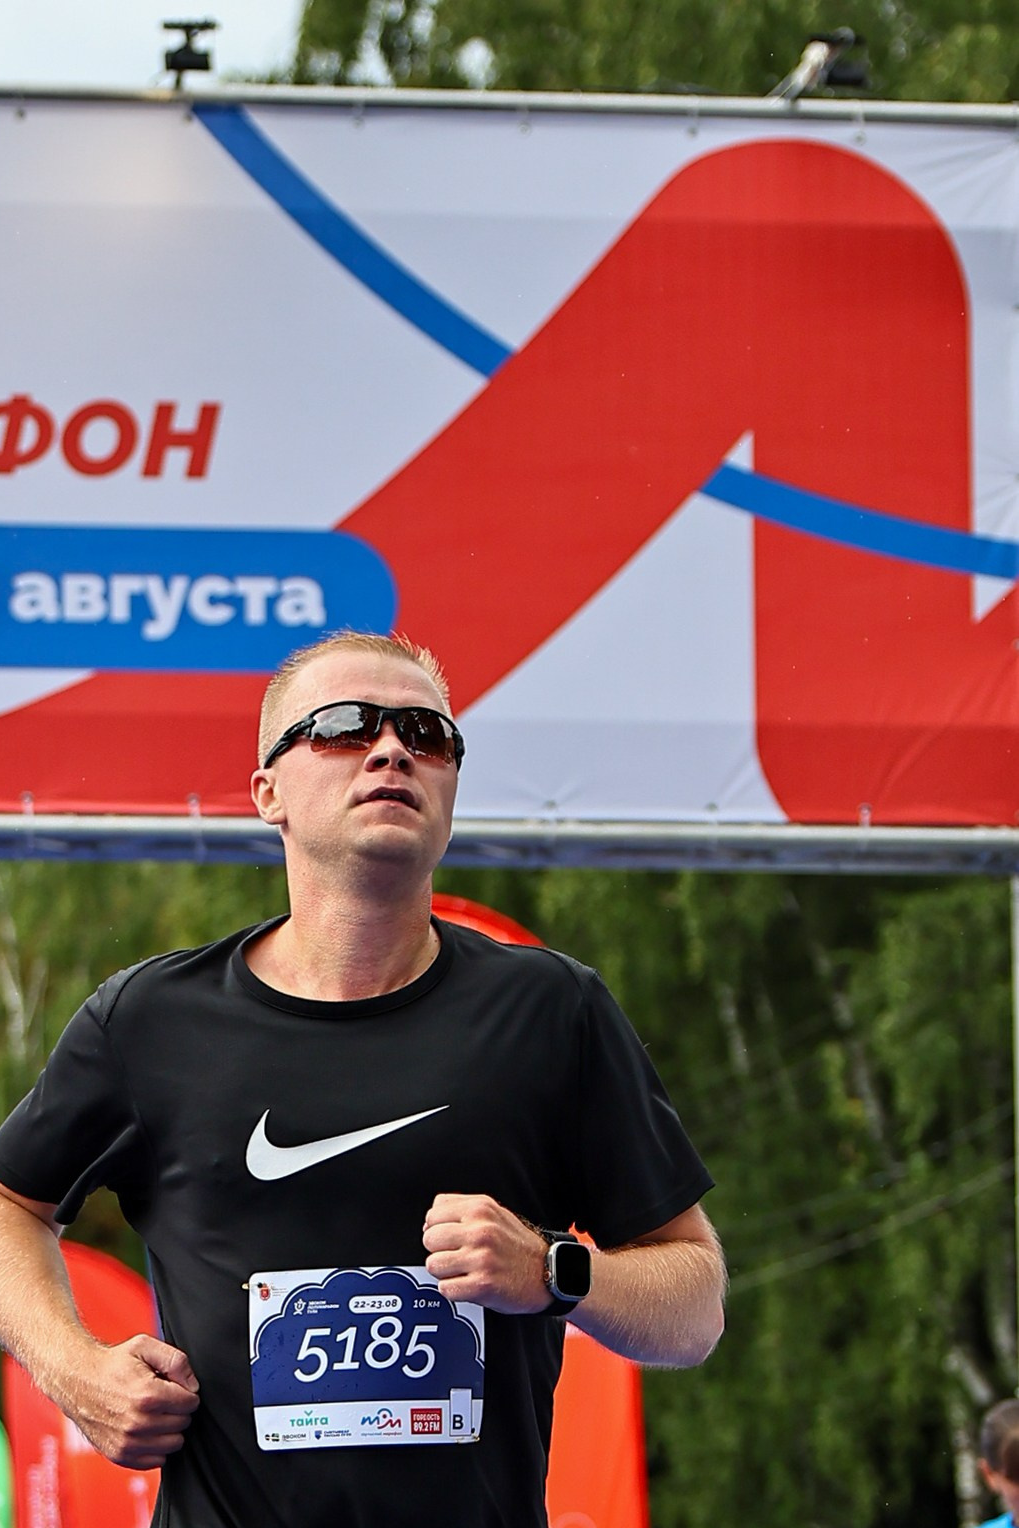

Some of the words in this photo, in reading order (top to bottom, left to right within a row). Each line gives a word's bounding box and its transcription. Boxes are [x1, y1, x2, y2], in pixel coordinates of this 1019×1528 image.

[11, 569, 326, 641] августа
[354, 1299, 398, 1309] 22-23.08
[413, 1299, 426, 1308] 10
[294, 1316, 438, 1383] 5185
[290, 1410, 329, 1427] тайга
[452, 1414, 464, 1430] B
[413, 1422, 428, 1432] 89.2
[429, 1422, 440, 1431] FM
